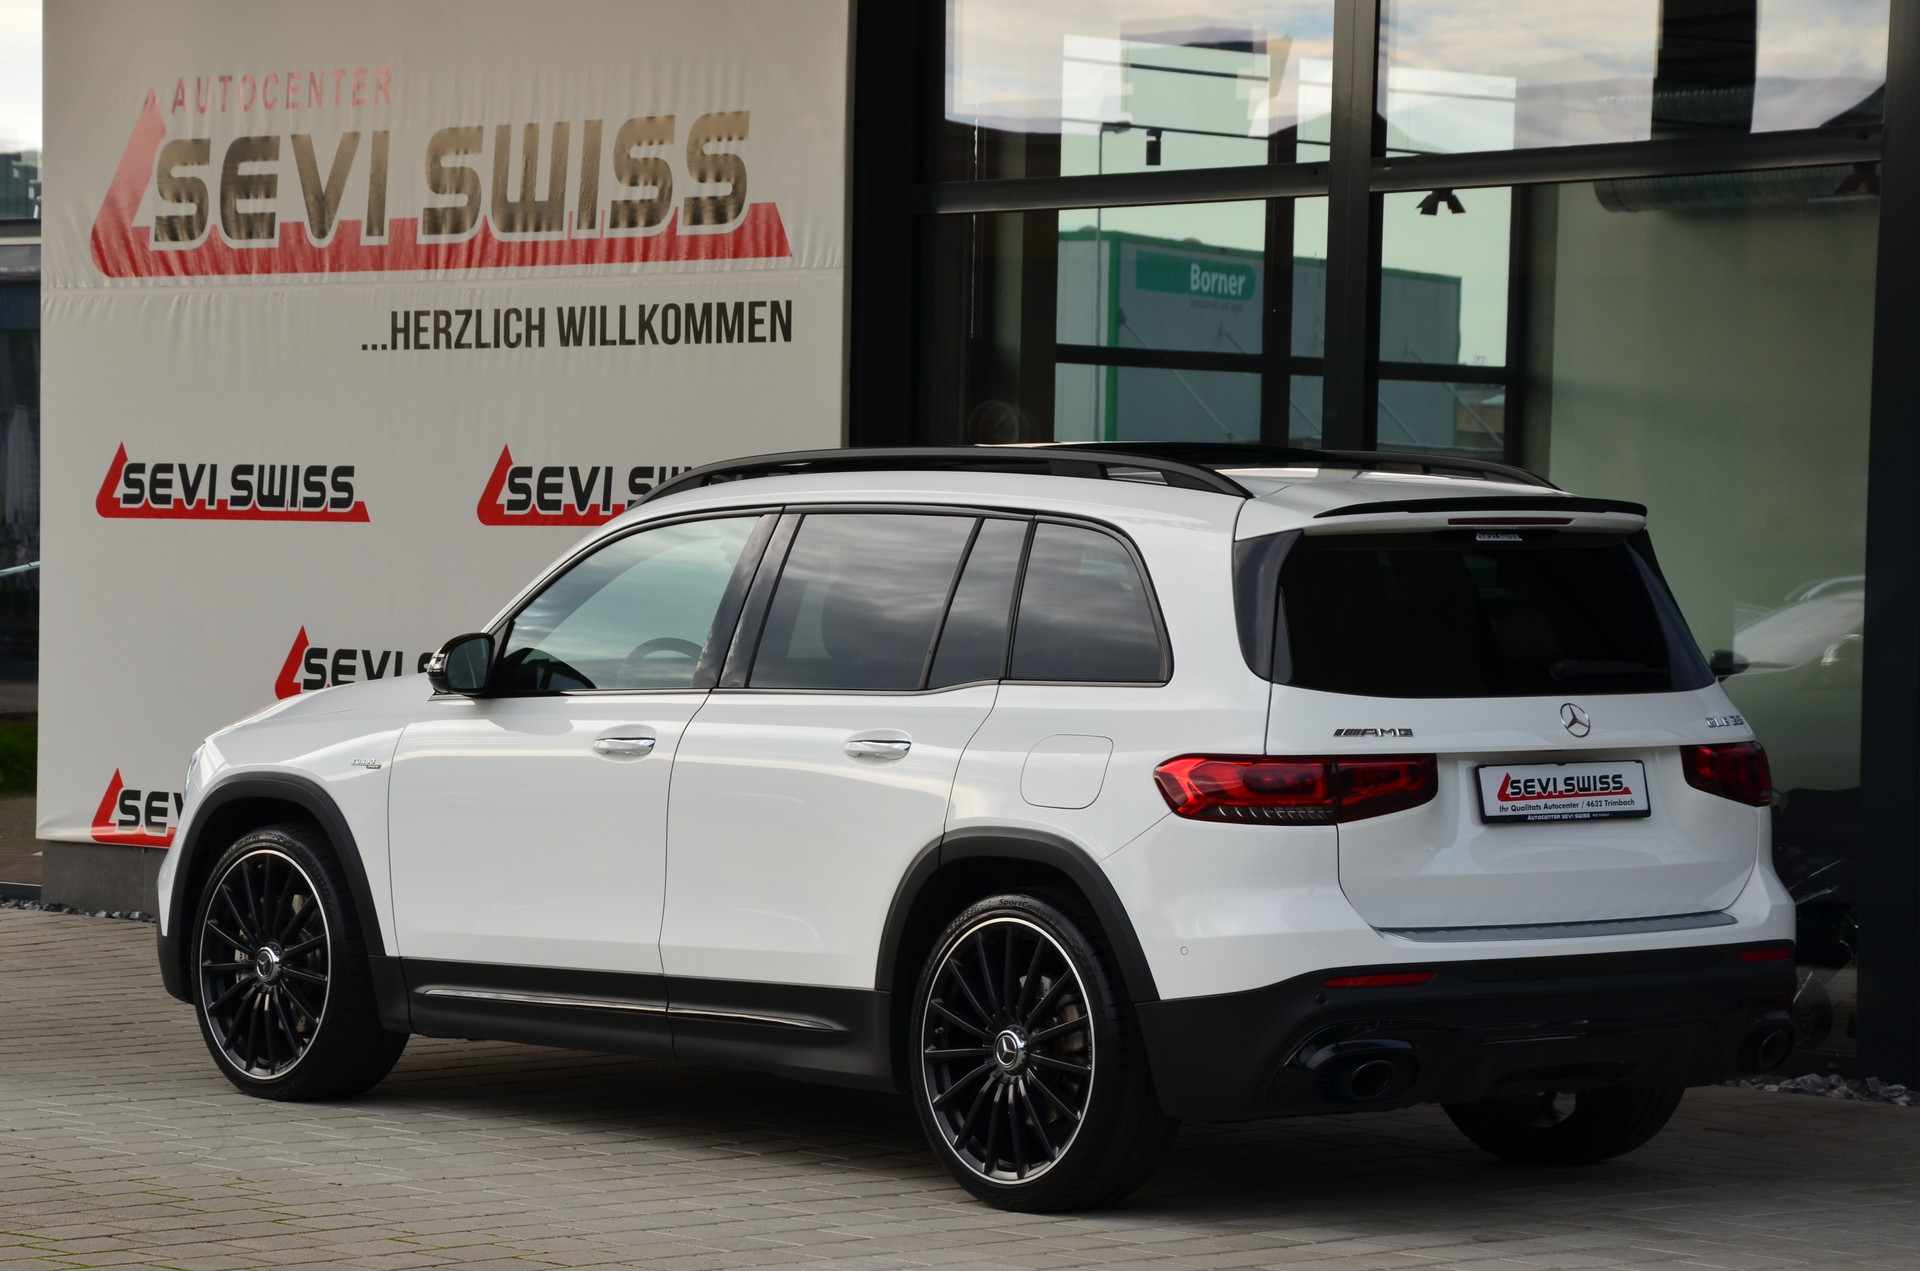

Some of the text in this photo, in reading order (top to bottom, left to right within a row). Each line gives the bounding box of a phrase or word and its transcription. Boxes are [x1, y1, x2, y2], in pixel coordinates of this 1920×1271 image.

[171, 67, 393, 115] AUTOCENTER
[154, 111, 751, 242] SEVI SWISS
[1190, 263, 1246, 296] Borner
[361, 300, 793, 351] ...HERZLICH WILLKOMMEN
[122, 462, 355, 509] SEVI SWISS
[506, 466, 614, 512] SEVI
[1509, 774, 1624, 796] SEVI SWISS
[1543, 802, 1579, 810] Autocenter
[1586, 800, 1603, 808] 4632
[1604, 798, 1635, 806] Trimbach
